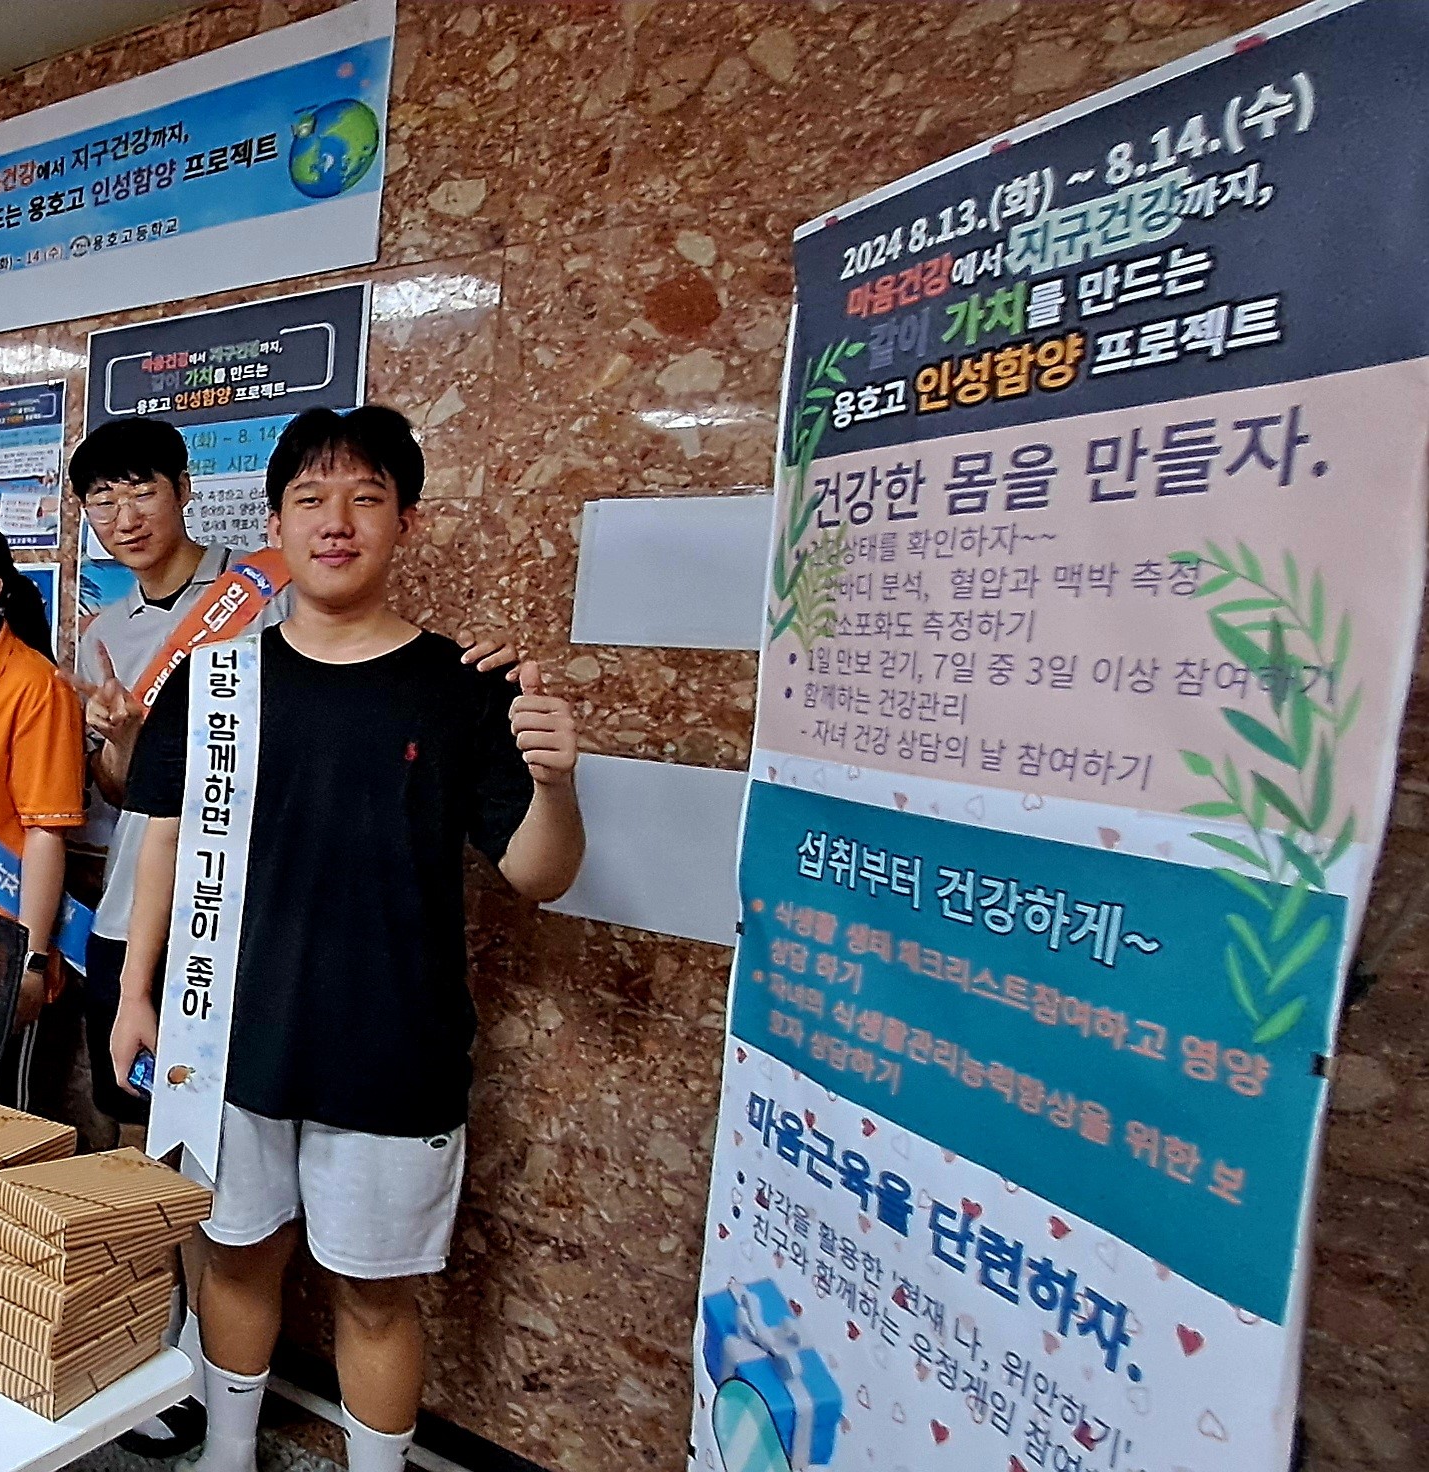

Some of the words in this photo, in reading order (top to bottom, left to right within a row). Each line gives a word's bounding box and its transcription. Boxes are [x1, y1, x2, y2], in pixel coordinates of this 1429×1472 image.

[28, 186, 85, 222] 용호고
[92, 159, 177, 205] 인성함양
[183, 132, 279, 183] 프로젝트
[72, 121, 190, 170] 지구건강까지,
[840, 227, 903, 281] 2024
[908, 166, 1055, 254] 8.13.(화)
[1106, 71, 1316, 185] 8.14.(수)
[92, 218, 179, 252] 용호고등학교
[846, 240, 1006, 319] 마음건강에서
[1010, 162, 1275, 273] 지구건강까지,
[870, 307, 932, 370] 같이
[941, 278, 1066, 346] 가치를
[1078, 247, 1212, 319] 만드는
[136, 397, 172, 415] 용호고
[174, 386, 232, 411] 인성함양
[234, 381, 287, 402] 프로젝트
[230, 363, 270, 382] 만드는
[832, 379, 907, 430] 용호고
[915, 332, 1086, 414] 인성함양
[1091, 296, 1282, 377] 프로젝트
[227, 453, 258, 473] 시간
[812, 459, 926, 528] 건강한
[943, 438, 1058, 516] 몸을
[1084, 403, 1329, 505] 만들자.
[882, 571, 929, 602] 분석,
[950, 565, 1040, 600] 혈압과
[1053, 561, 1119, 598] 맥박
[1130, 558, 1202, 597] 측정
[906, 522, 1058, 560] 확인하자~~
[923, 609, 1036, 643] 측정하기
[208, 648, 242, 700] 너랑
[803, 682, 872, 715] 함께하는
[878, 688, 968, 725] 건강관리
[807, 646, 830, 676] 1일
[836, 649, 872, 676] 만보
[879, 650, 923, 684] 걷기,
[933, 651, 977, 684] 7일
[988, 653, 1015, 687] 중
[1025, 655, 1077, 691] 3일
[1092, 655, 1160, 695] 이상
[200, 710, 242, 837] 함께하면
[811, 719, 848, 748] 자녀
[854, 725, 891, 756] 건강
[897, 730, 969, 767] 상담의
[980, 737, 1007, 772] 날
[1017, 741, 1153, 791] 참여하기
[190, 850, 227, 944] 기분이
[796, 828, 923, 910] 섭취부터
[934, 864, 1162, 969] 건강하게~
[181, 954, 215, 1022] 좋아
[774, 900, 838, 945] 식생활
[1181, 1034, 1271, 1098] 영양
[816, 951, 863, 995] 하기
[1125, 1119, 1201, 1185] 위한
[1207, 1159, 1246, 1206] 보
[745, 1090, 913, 1239] 마음근육을
[927, 1199, 1143, 1384] 단련하자.
[753, 1214, 810, 1276] 친구와
[815, 1257, 900, 1348] 함께하는
[909, 1332, 1016, 1438] 우정게임
[818, 1220, 885, 1291] 활용한
[954, 1317, 990, 1373] 나,
